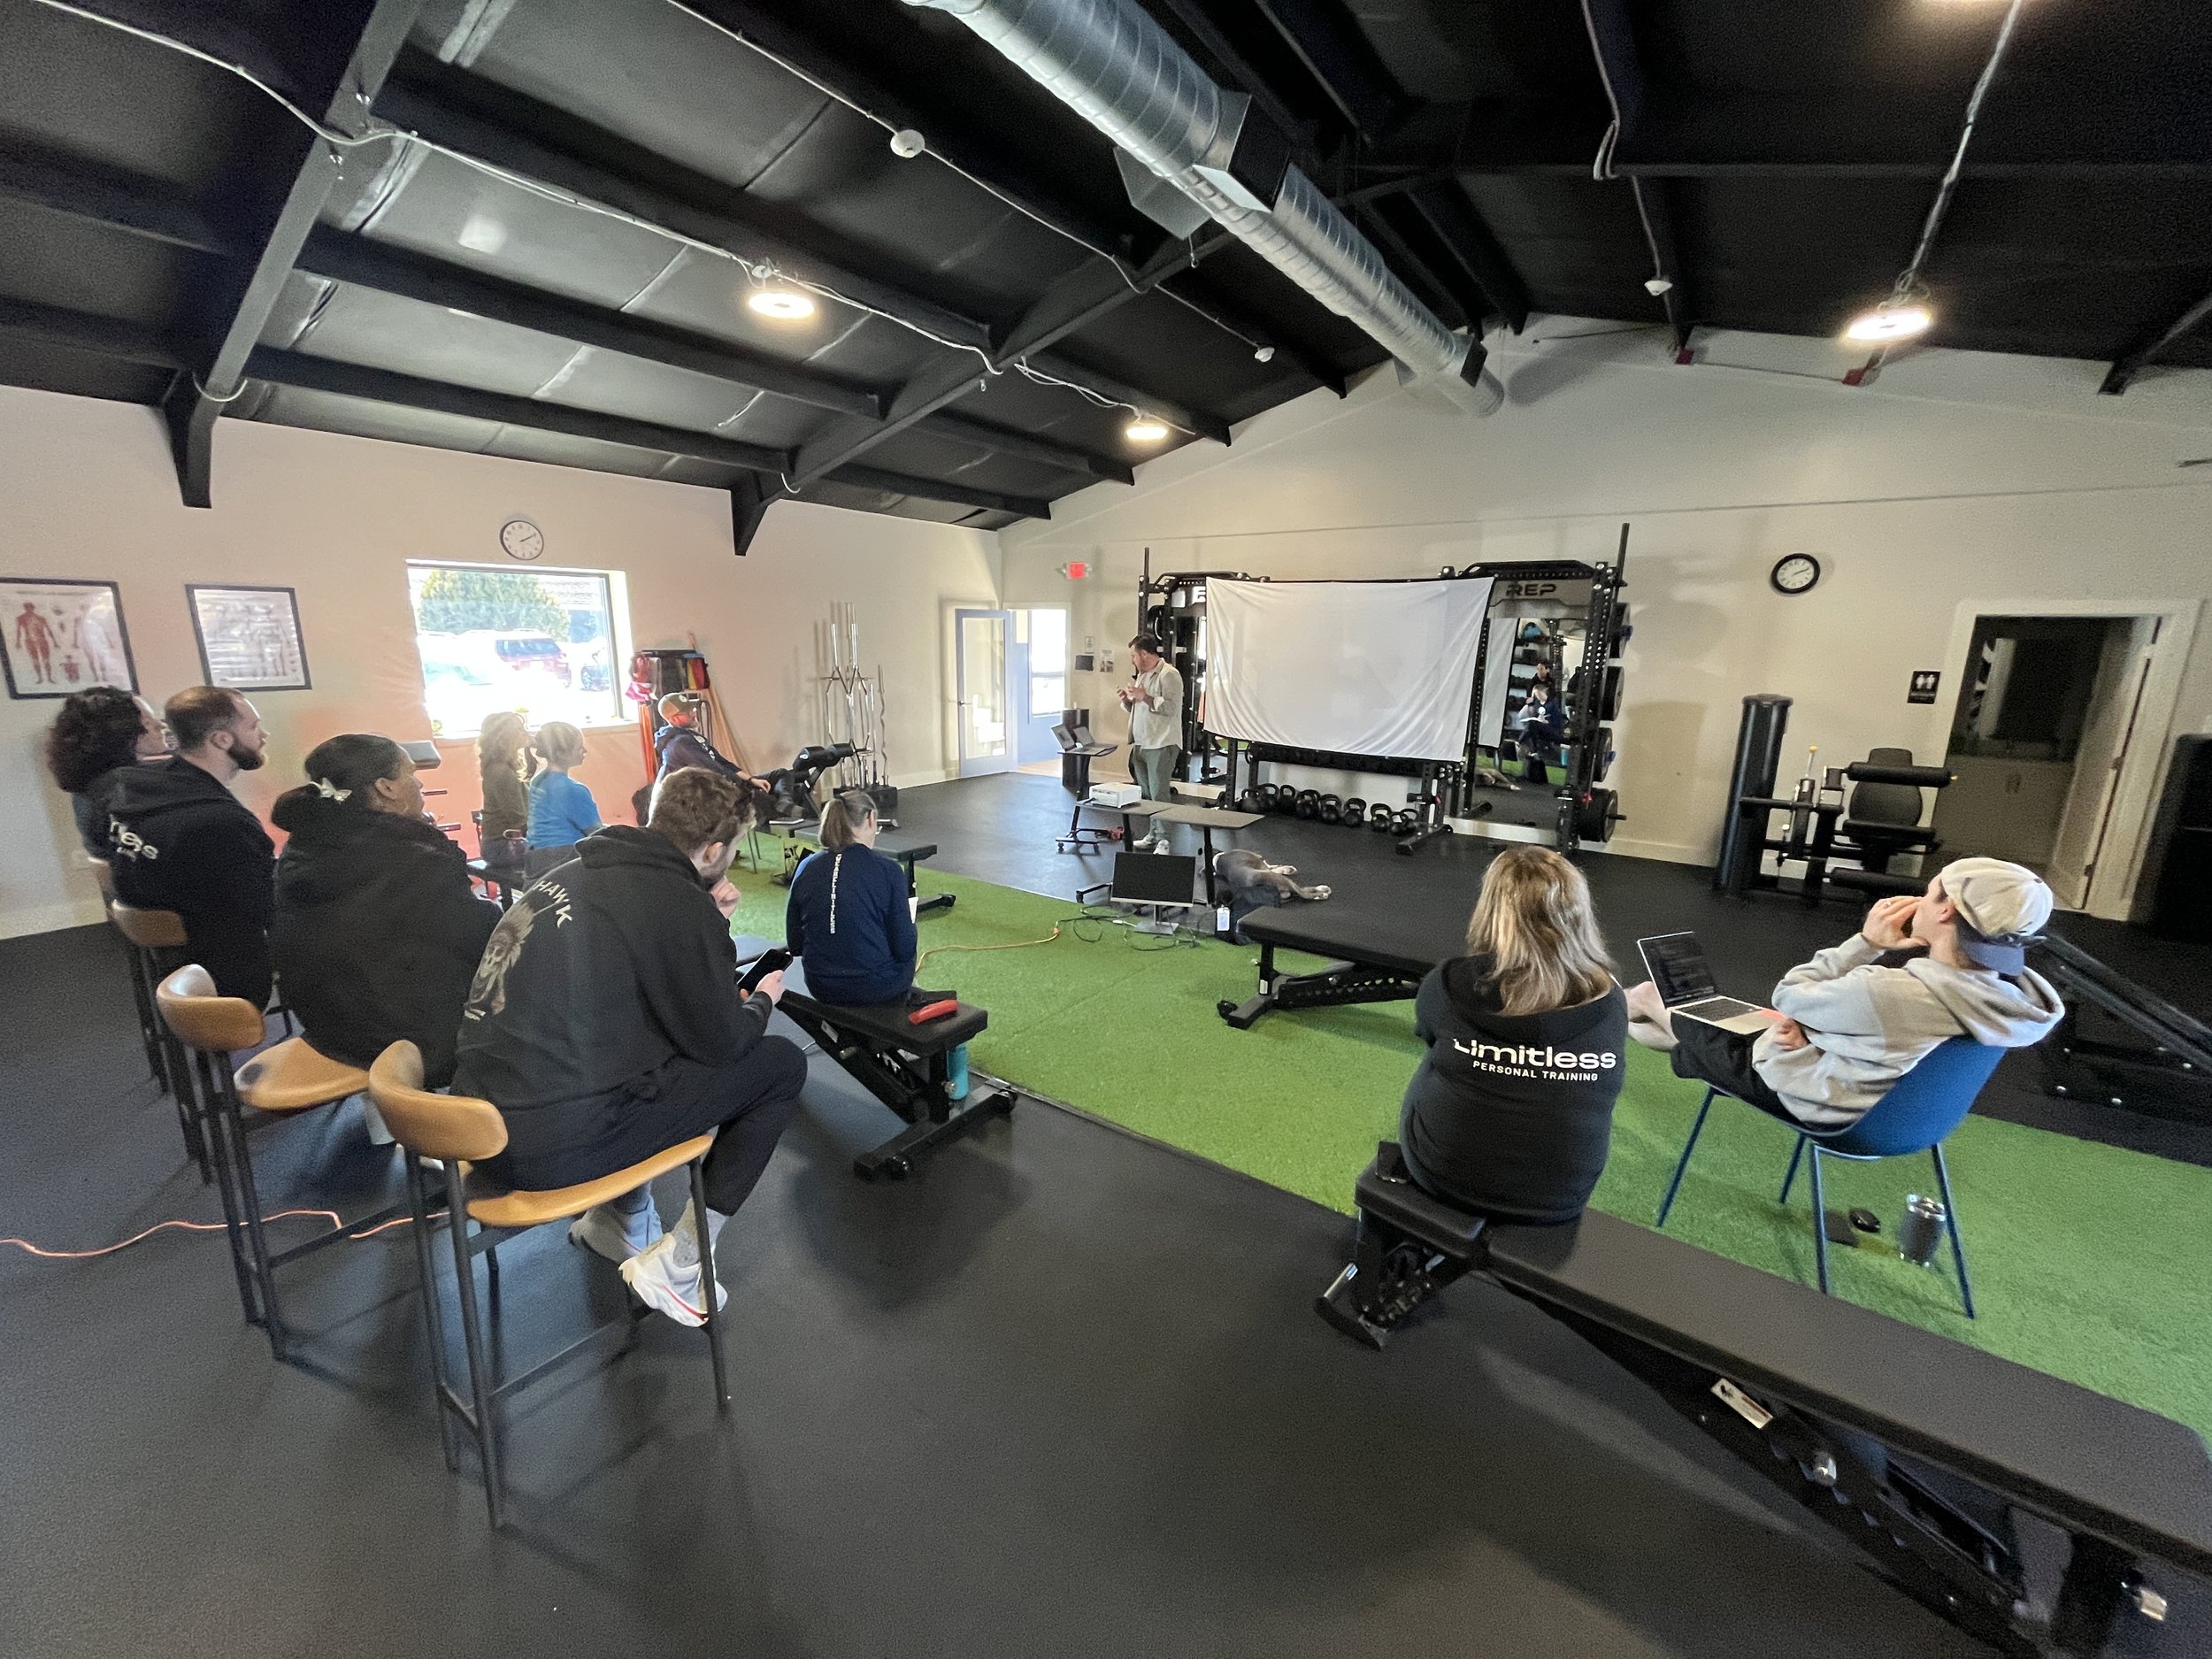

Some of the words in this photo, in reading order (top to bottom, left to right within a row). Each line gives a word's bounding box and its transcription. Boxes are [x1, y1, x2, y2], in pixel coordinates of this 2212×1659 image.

[1506, 584, 1556, 596] REP
[1453, 1038, 1617, 1070] Limitless
[1472, 1061, 1538, 1079] PERSONAL
[1542, 1070, 1599, 1081] TRAINING
